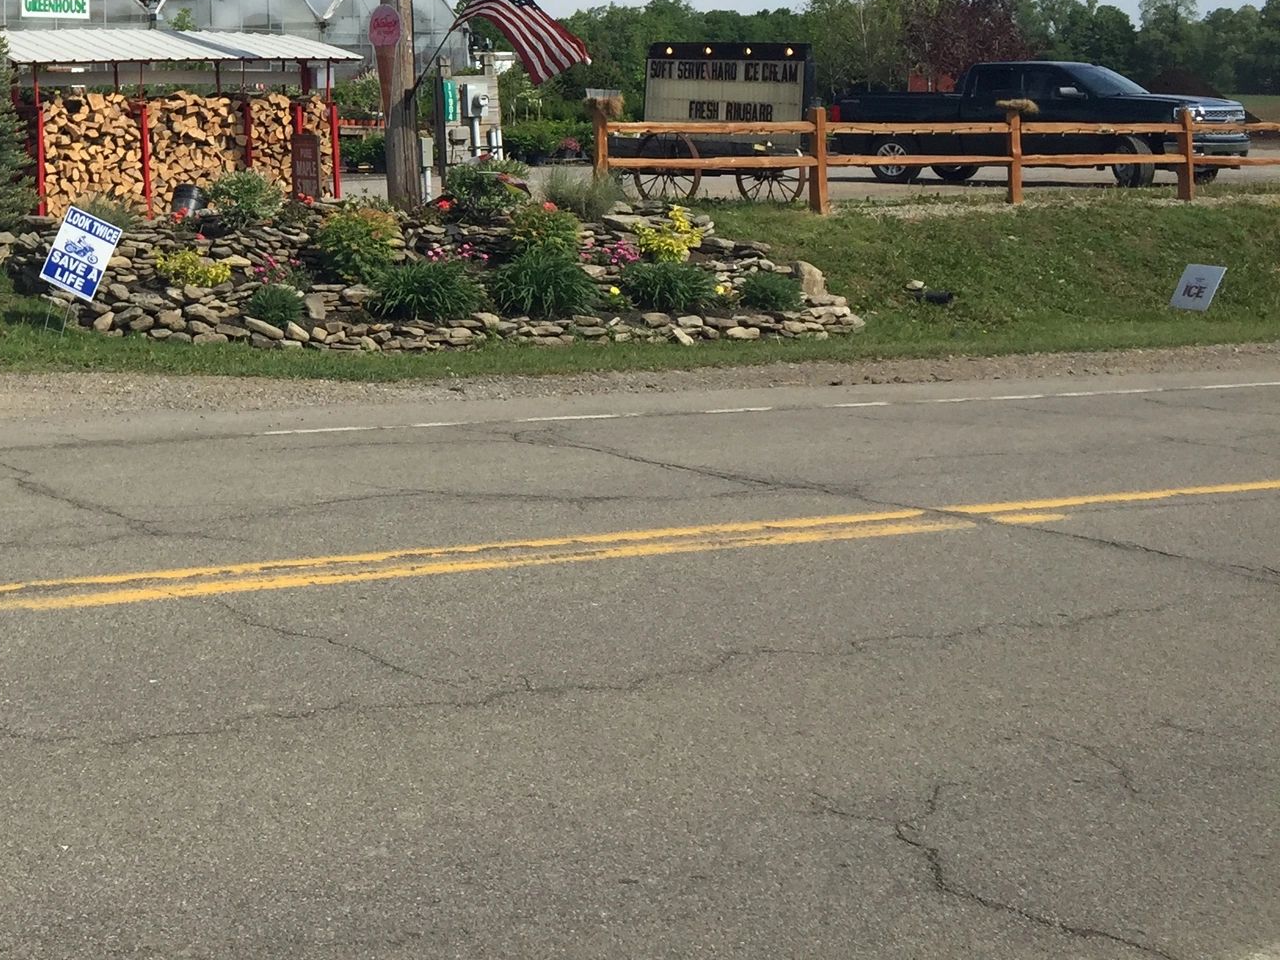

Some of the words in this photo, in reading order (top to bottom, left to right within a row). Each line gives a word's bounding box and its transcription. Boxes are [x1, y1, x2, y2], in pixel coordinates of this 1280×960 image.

[650, 61, 673, 79] SOFT
[744, 63, 759, 81] ICE
[762, 63, 798, 82] CREAM
[689, 100, 719, 120] FRESH
[725, 101, 773, 121] RHUBARB
[67, 210, 93, 231] LOOK
[91, 221, 119, 243] TWICE
[51, 250, 88, 276] SAVE
[87, 268, 98, 282] A
[54, 268, 86, 291] LIFE
[1182, 284, 1207, 298] ICE
